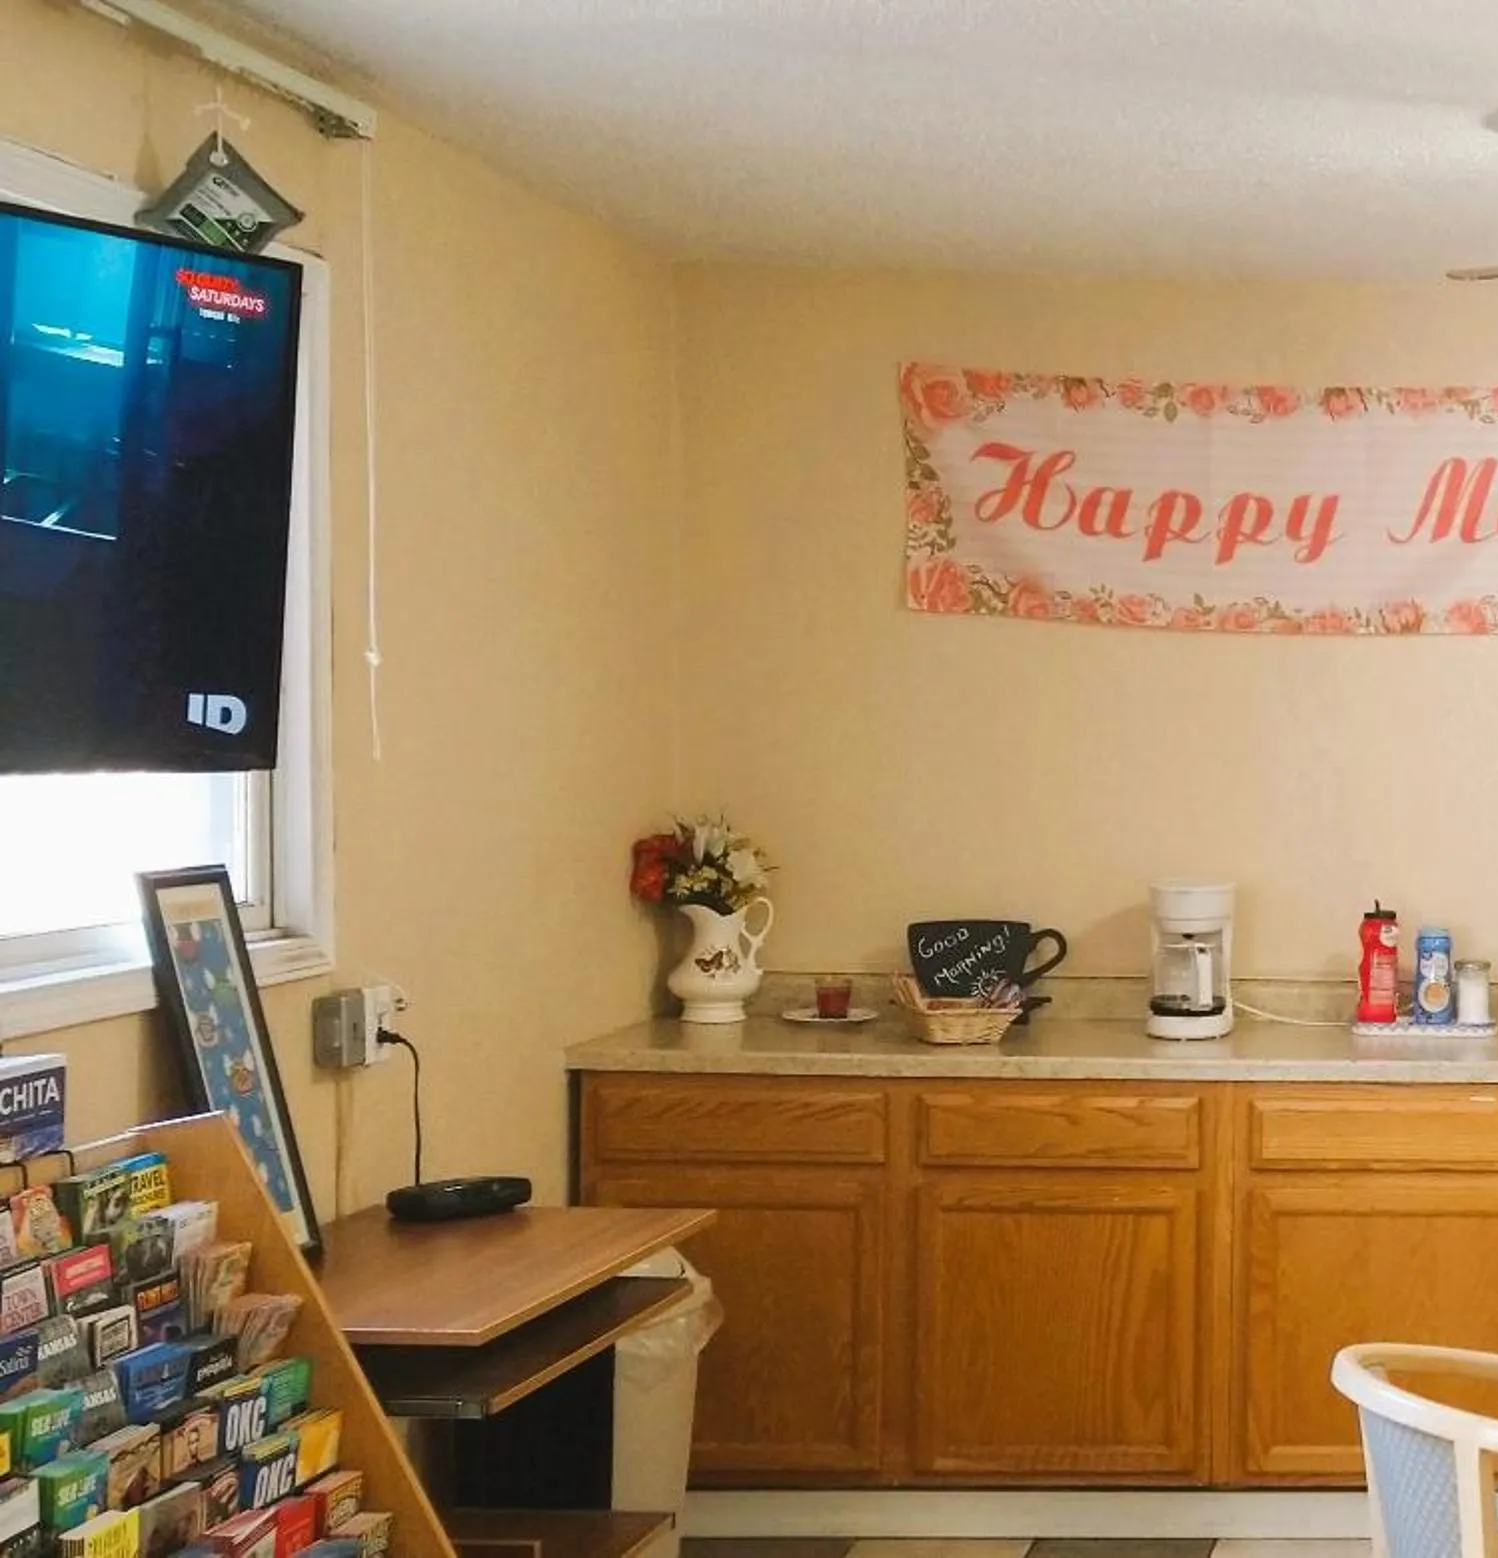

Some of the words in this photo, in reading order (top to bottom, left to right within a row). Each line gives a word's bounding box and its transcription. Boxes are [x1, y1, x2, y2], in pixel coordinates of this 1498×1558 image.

[190, 286, 265, 312] SATURDAYS
[970, 442, 1347, 566] Happy
[187, 692, 246, 735] ID
[0, 1076, 60, 1116] CHITA
[225, 1395, 267, 1451] OKC
[253, 1453, 295, 1510] OKC
